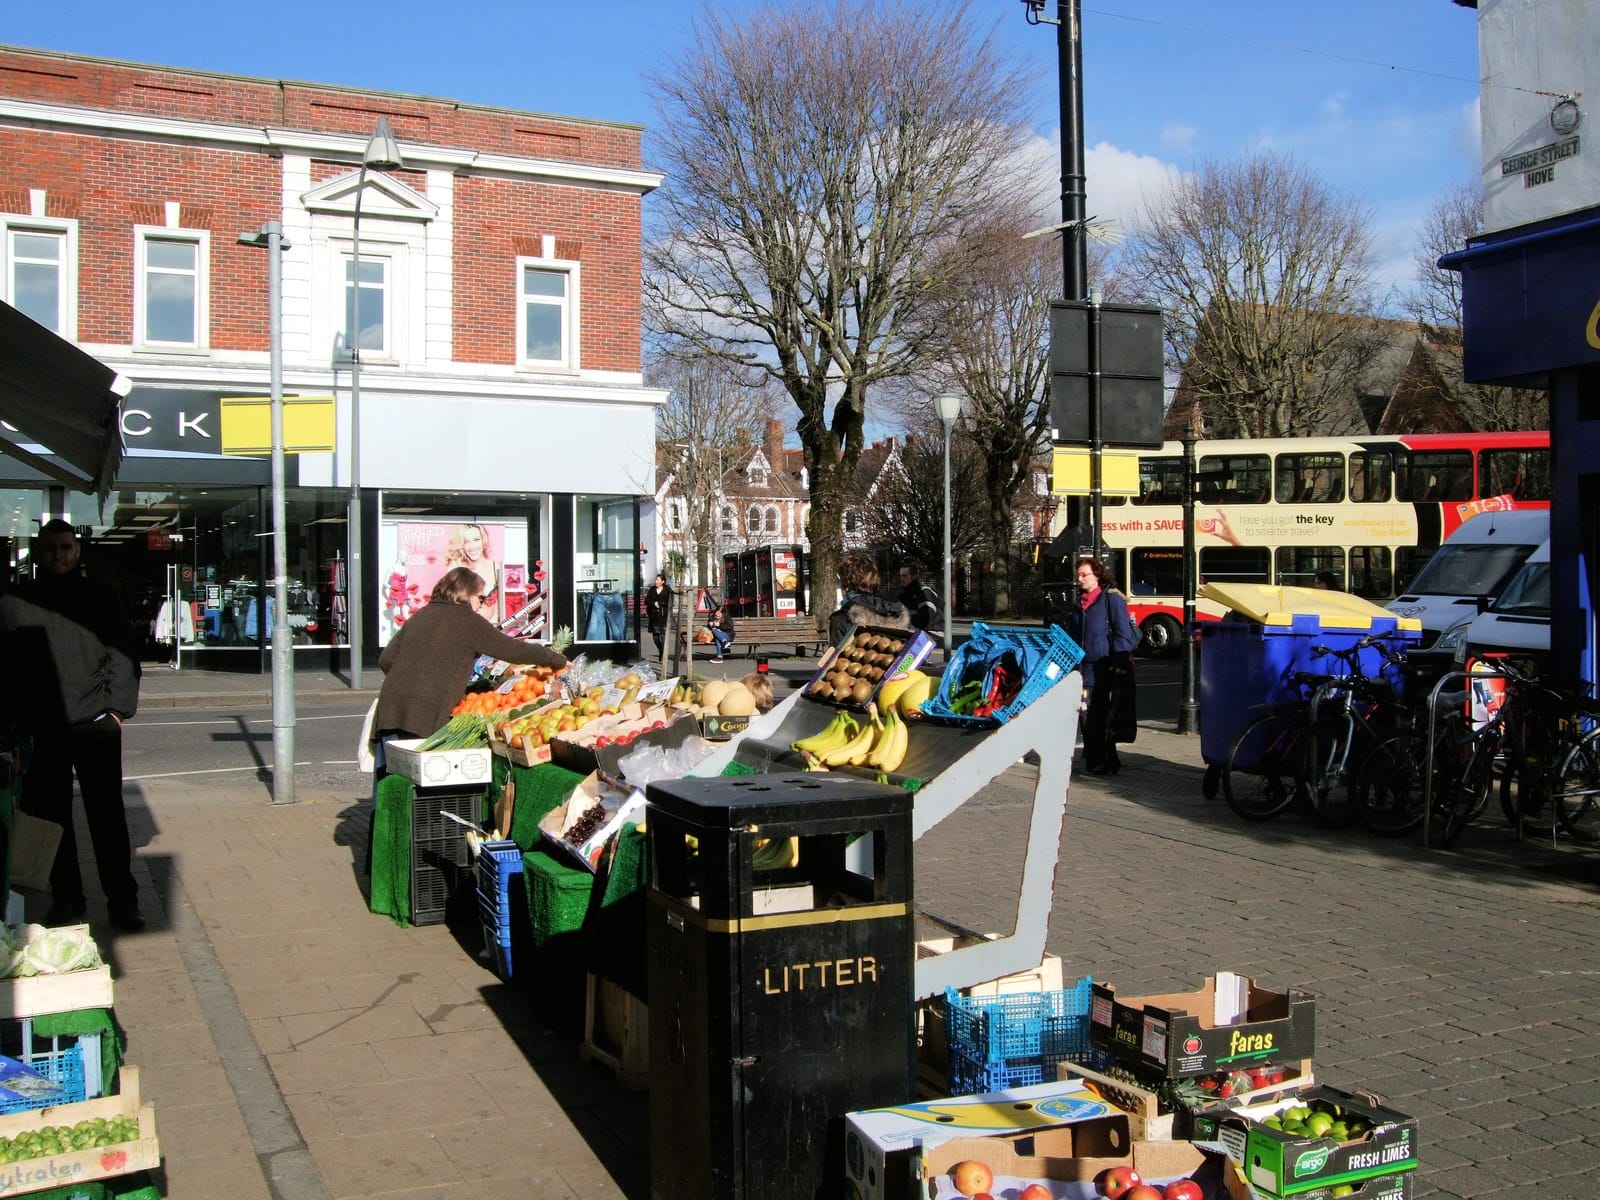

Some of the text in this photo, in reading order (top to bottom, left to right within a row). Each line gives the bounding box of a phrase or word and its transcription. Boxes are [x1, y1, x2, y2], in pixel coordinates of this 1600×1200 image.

[1502, 140, 1578, 174] GEORGE STREET
[1527, 168, 1553, 187] HOVE
[1101, 519, 1184, 531] ess with a SAVE
[1240, 515, 1259, 525] have
[1260, 517, 1277, 527] you
[1279, 515, 1294, 527] got
[1296, 514, 1313, 524] the
[1316, 514, 1334, 526] key
[1245, 528, 1319, 536] to smarter travel?
[765, 956, 876, 994] LITTER
[1115, 1024, 1137, 1045] faras
[1230, 1030, 1273, 1058] faras
[1301, 1156, 1324, 1171] argo
[1348, 1151, 1379, 1170] FRESH
[1382, 1144, 1410, 1164] LIMES
